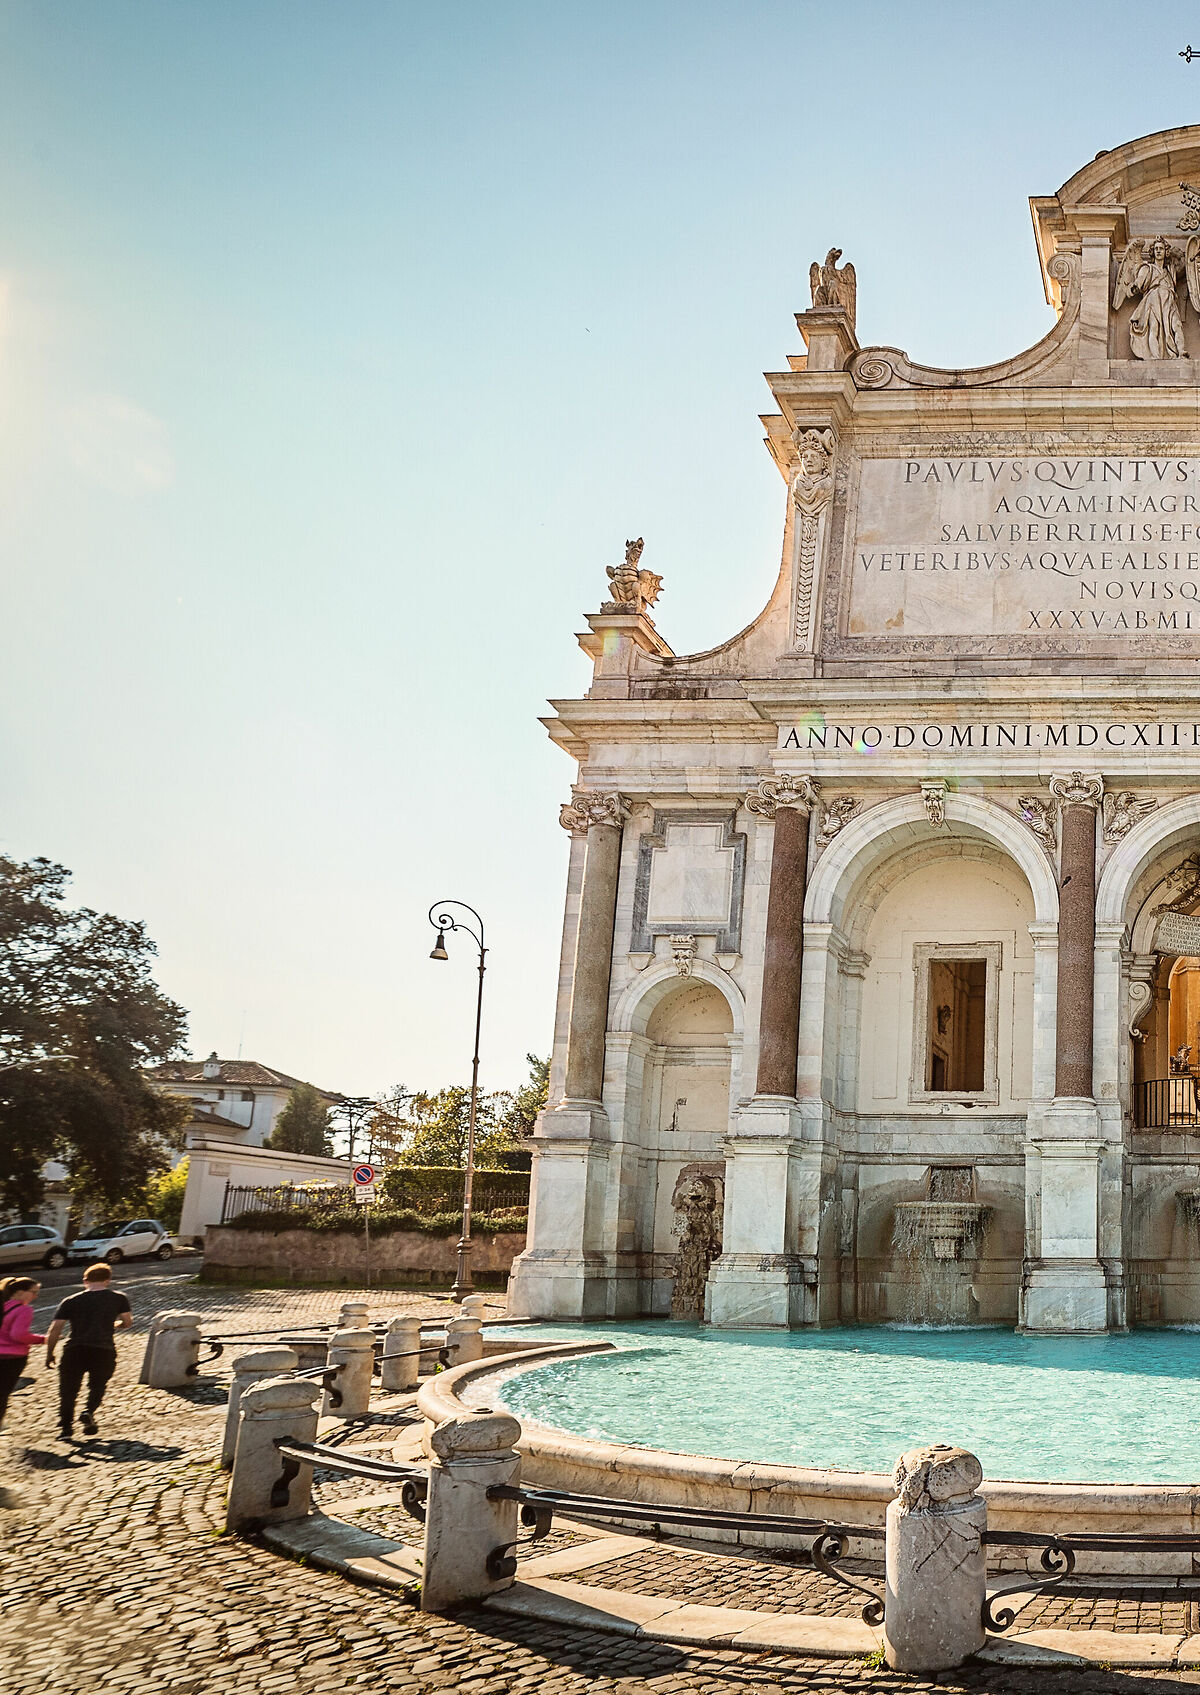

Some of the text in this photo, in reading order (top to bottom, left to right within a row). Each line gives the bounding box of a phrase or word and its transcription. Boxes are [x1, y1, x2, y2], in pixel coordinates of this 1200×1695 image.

[904, 461, 1023, 484] PAVLVS
[1034, 461, 1188, 490] QVINTVS
[995, 495, 1098, 519] AQVAM
[1105, 495, 1137, 513] IN
[940, 523, 1153, 543] SALVBERRIMIS
[1160, 523, 1172, 542] E
[859, 552, 1011, 572] VETERIBVS
[1020, 552, 1112, 577] AQVAE
[1028, 610, 1105, 629] XXXV
[1114, 610, 1148, 629] AB
[782, 725, 883, 749] ANNO
[894, 724, 1031, 748] DOMINI
[1044, 723, 1179, 747] MDCXII
